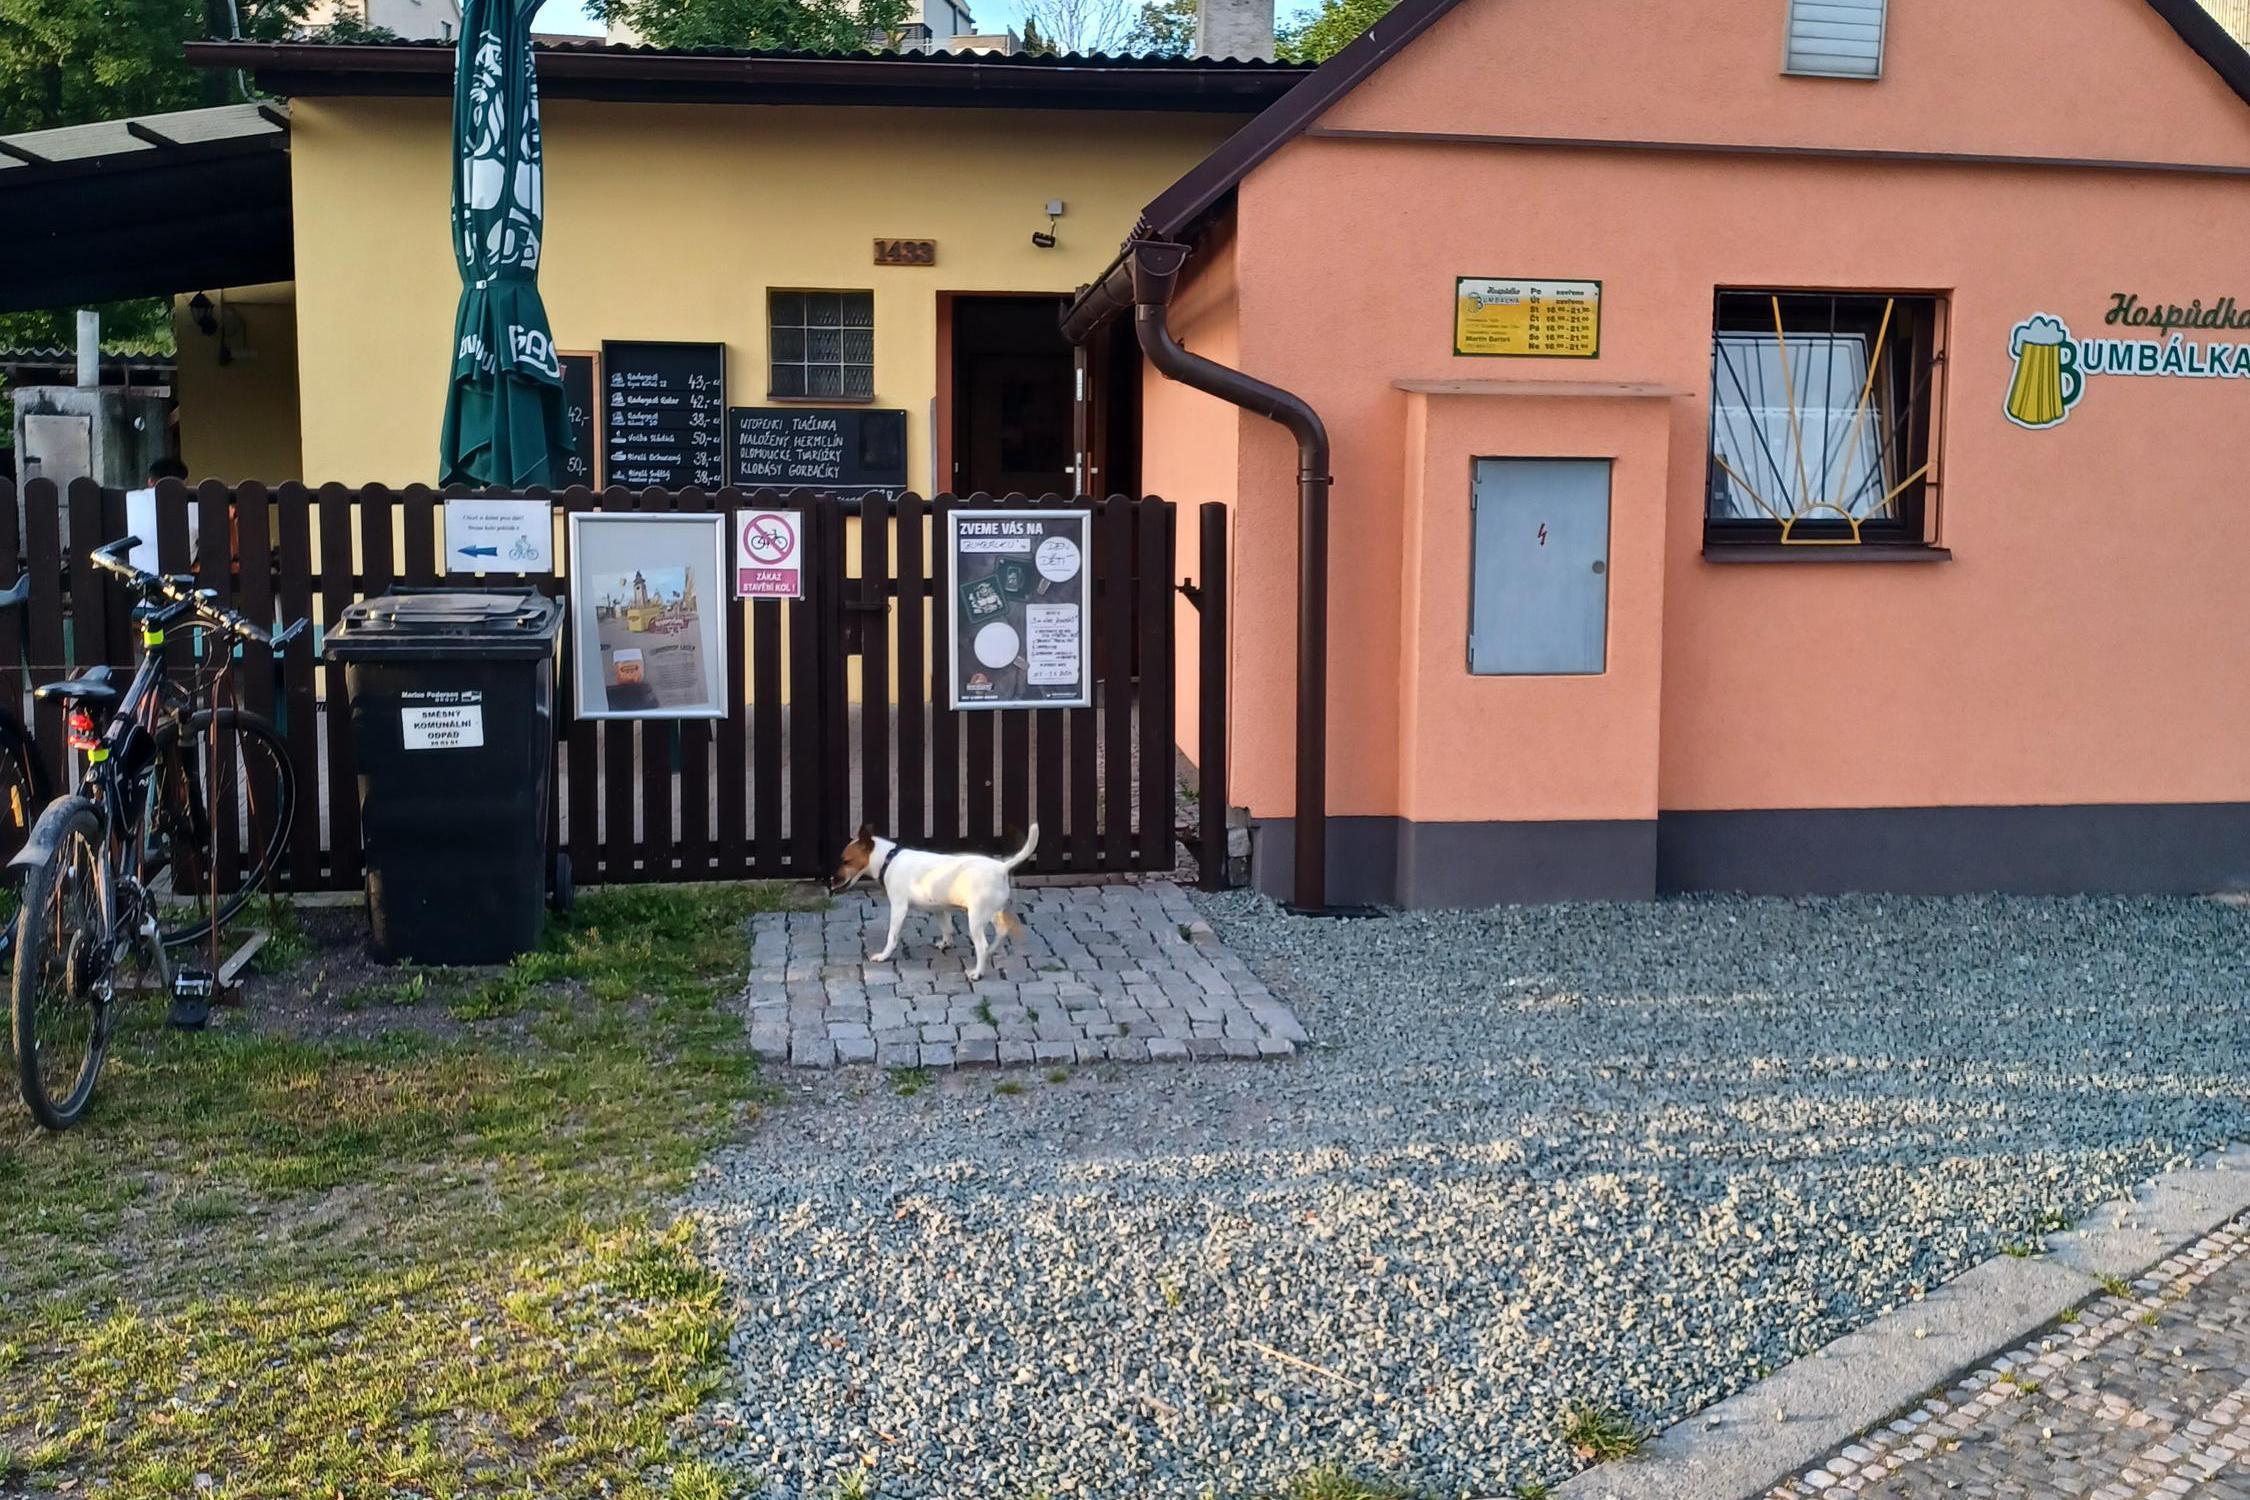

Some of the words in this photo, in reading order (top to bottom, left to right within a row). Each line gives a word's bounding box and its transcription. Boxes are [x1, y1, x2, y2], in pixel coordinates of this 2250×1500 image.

[2104, 293, 2250, 337] Hospůdka
[960, 522, 999, 535] ZVEME
[1001, 521, 1024, 535] VÁS
[1026, 523, 1043, 535] NA
[756, 571, 782, 581] ZÁKAZ
[775, 583, 791, 592] KOL
[413, 720, 471, 729] KOMUNÁLNÍ
[427, 731, 460, 739] ODPAD
